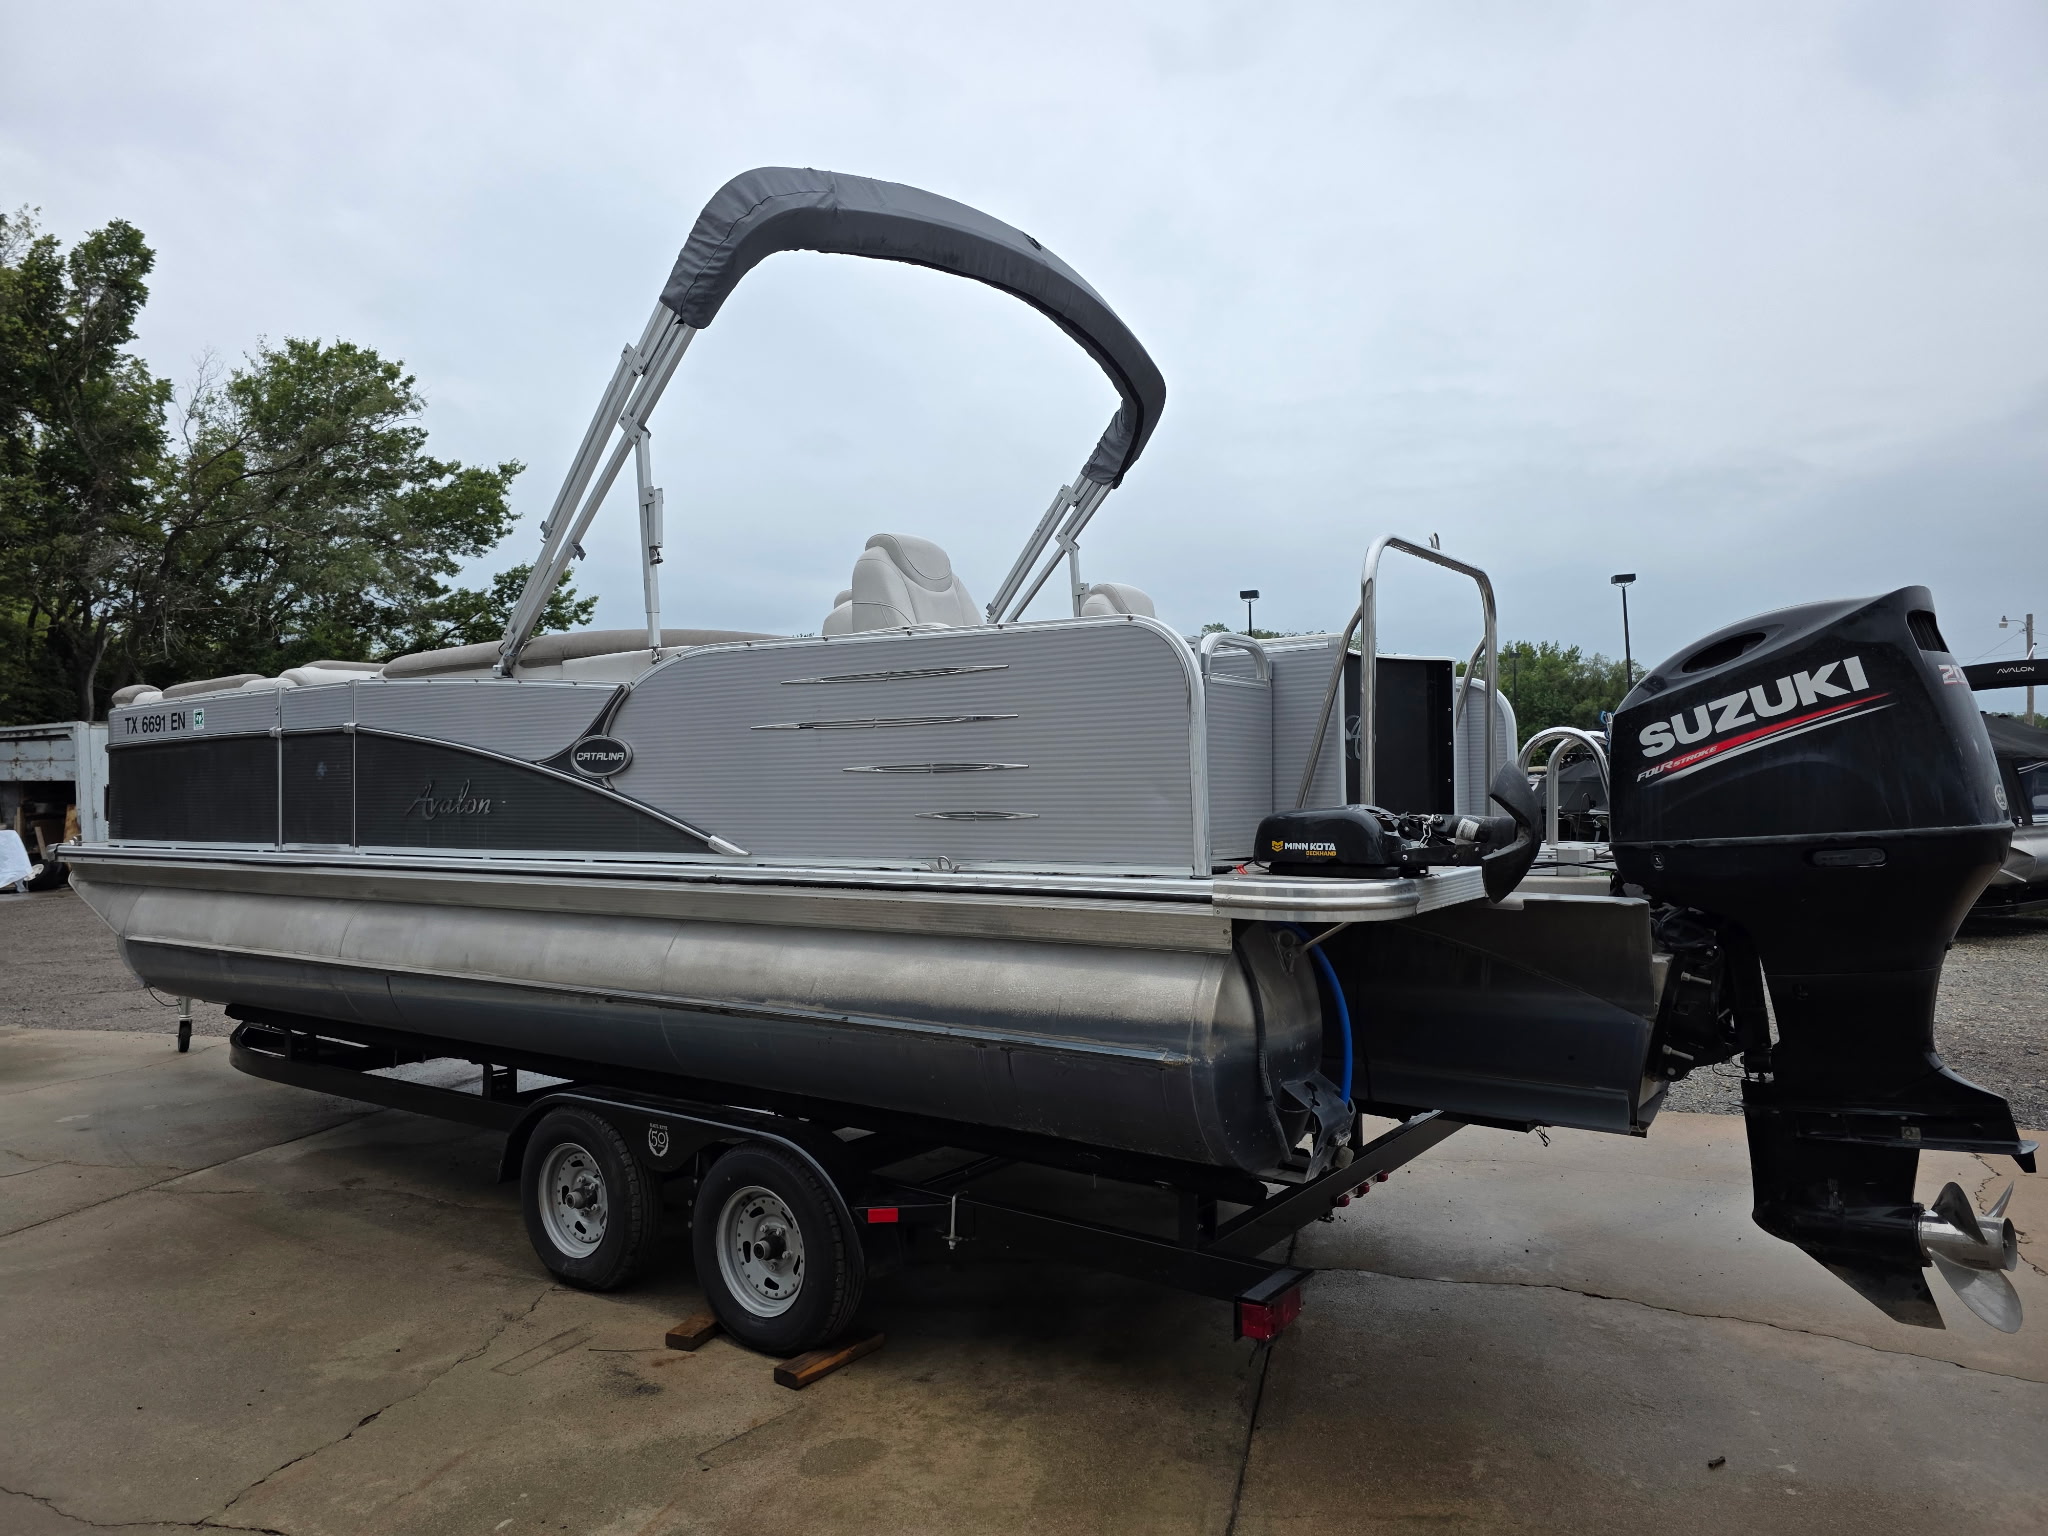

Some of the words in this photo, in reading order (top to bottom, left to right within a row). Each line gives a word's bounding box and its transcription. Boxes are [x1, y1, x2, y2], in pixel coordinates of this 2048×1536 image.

[1996, 666, 2035, 674] AVALON
[1639, 655, 1870, 758] SUZUKI
[125, 716, 138, 734] TX
[142, 715, 166, 733] 6691
[171, 712, 186, 731] EN
[576, 752, 625, 761] CATALINA
[404, 779, 492, 820] Avalon
[1284, 842, 1309, 850] MINN
[1310, 843, 1336, 851] KOTA
[651, 1130, 666, 1147] 50
